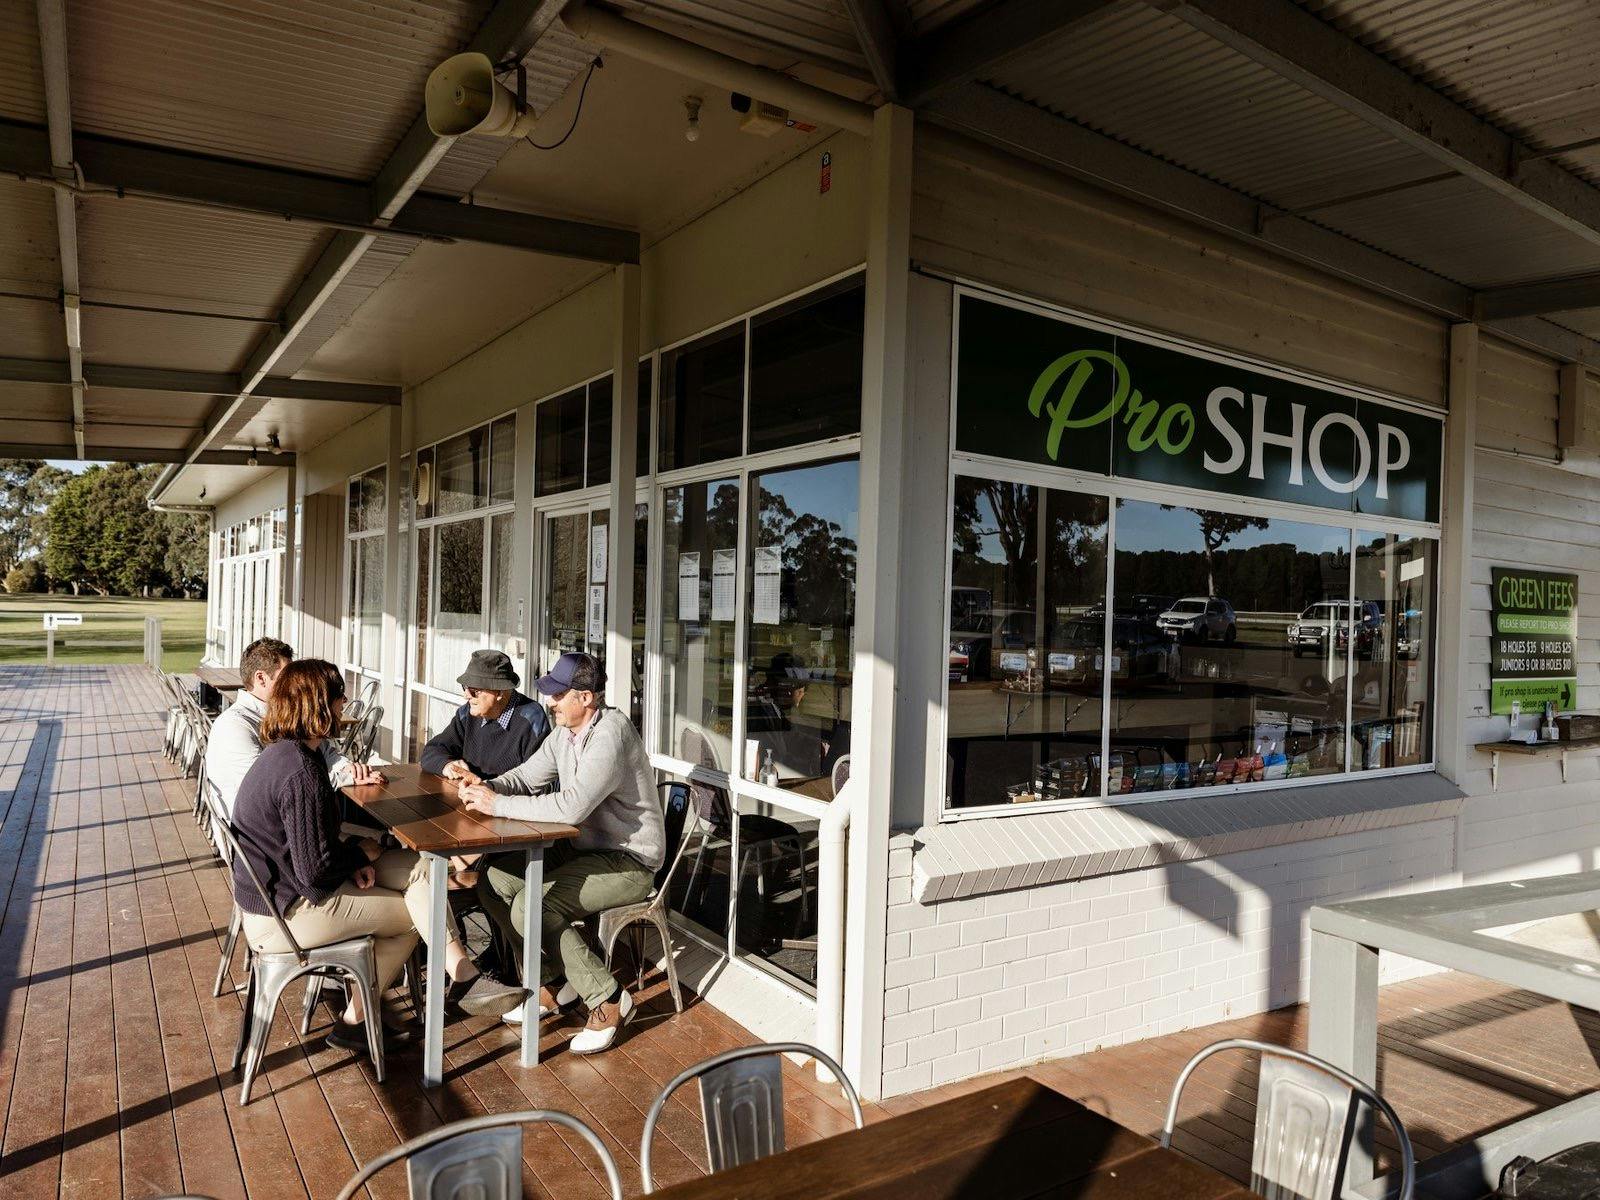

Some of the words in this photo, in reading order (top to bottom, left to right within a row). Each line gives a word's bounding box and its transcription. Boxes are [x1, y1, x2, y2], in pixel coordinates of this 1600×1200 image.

[1028, 350, 1195, 461] Pro
[1203, 386, 1411, 500] SHOP
[1499, 576, 1545, 609] GREEN
[1547, 581, 1574, 611] FEES
[1500, 640, 1507, 653] 18
[1507, 640, 1526, 653] HOLES
[1540, 641, 1545, 654] 9
[1545, 642, 1562, 654] HOLES
[1562, 642, 1572, 654] $25
[1500, 658, 1525, 671] JUNIORS
[1525, 658, 1530, 671] 9
[1531, 658, 1540, 671] OR
[1539, 658, 1546, 671] 18
[1546, 658, 1562, 671] HOLES
[1562, 658, 1572, 671] $10
[1505, 687, 1514, 698] pro
[1515, 686, 1527, 697] shop
[1532, 684, 1559, 695] unattended
